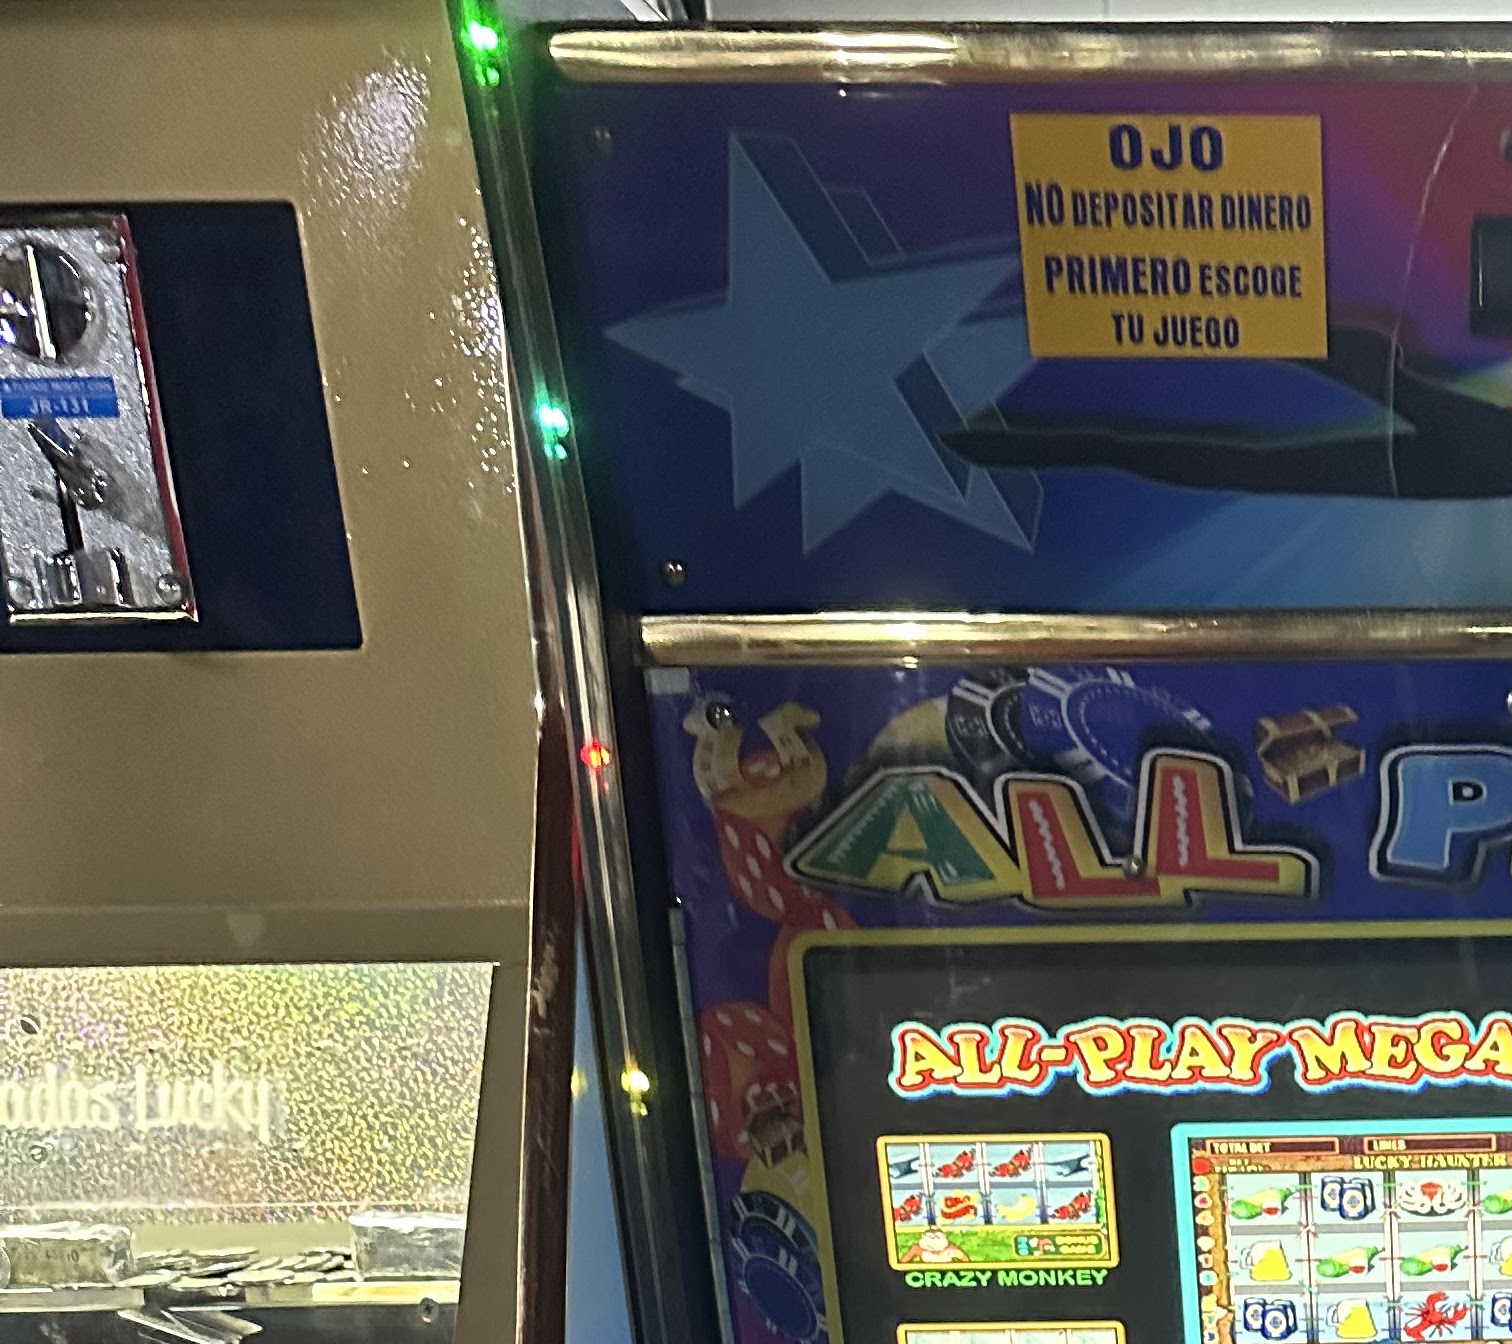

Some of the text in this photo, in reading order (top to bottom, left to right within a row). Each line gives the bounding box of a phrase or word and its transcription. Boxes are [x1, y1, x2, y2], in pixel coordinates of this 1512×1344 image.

[1109, 124, 1224, 171] OJO
[1024, 181, 1312, 230] NO DEPOSITAR DINERO
[1045, 255, 1302, 298] PRIMERO ESCOGE
[1112, 312, 1240, 348] TU JUEGO
[785, 748, 1320, 907] ALL
[893, 1018, 1284, 1093] ALL-PLAY
[905, 1267, 1108, 1289] CRAZY MONKEY
